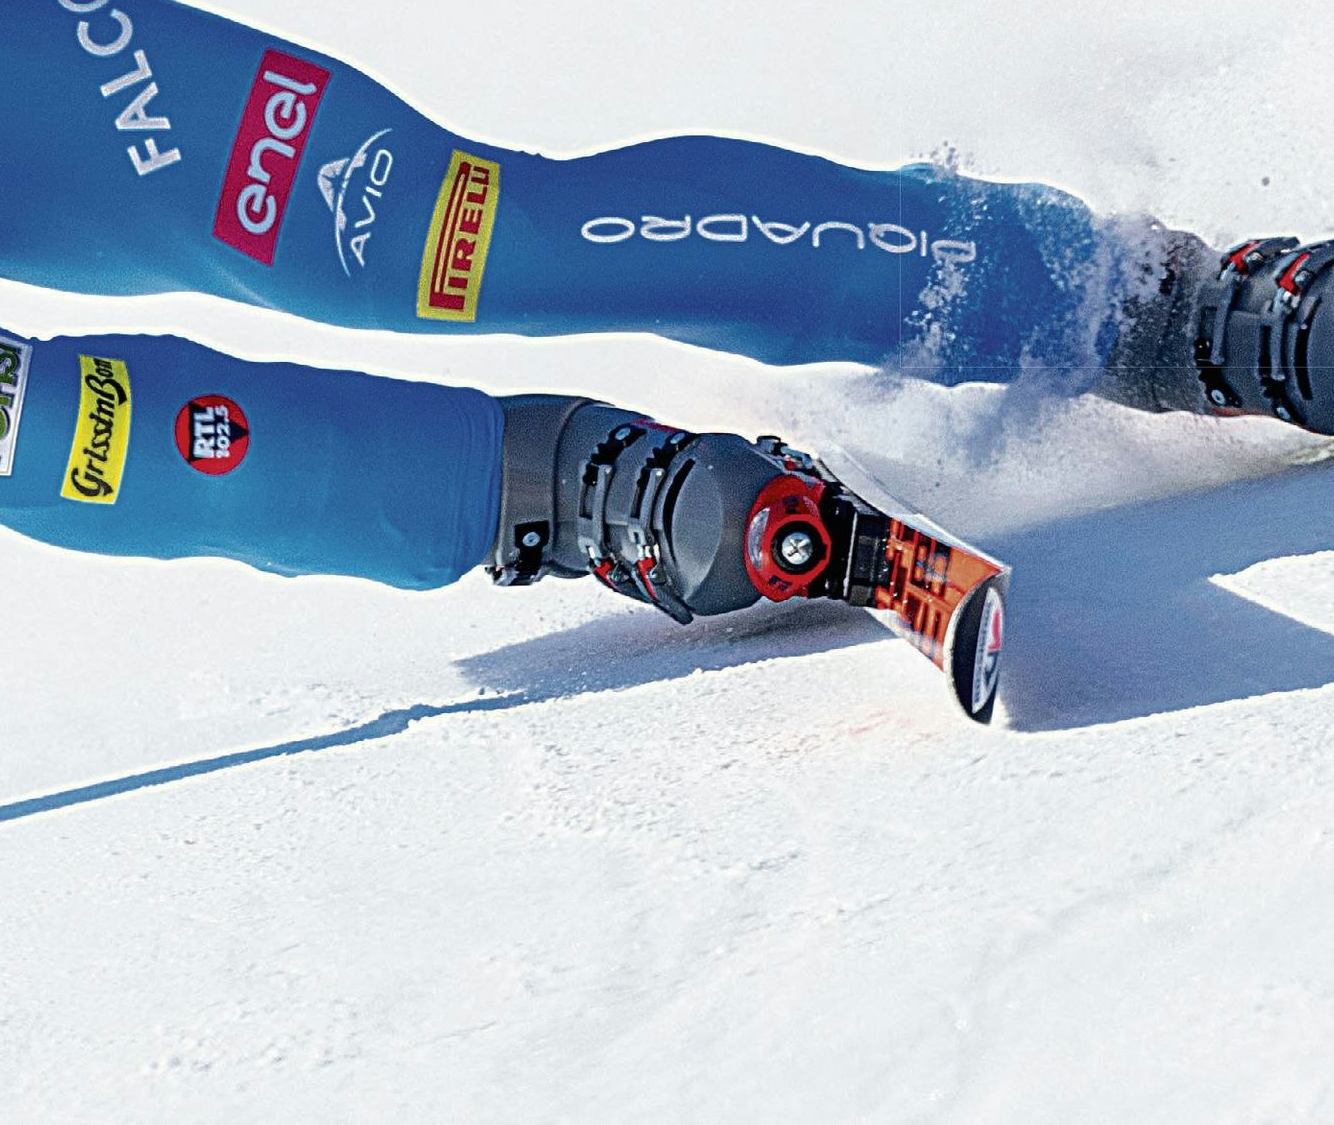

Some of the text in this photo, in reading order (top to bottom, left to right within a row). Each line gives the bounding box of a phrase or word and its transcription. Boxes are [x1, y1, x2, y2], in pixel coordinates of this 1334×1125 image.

[234, 70, 318, 237] enel
[349, 148, 394, 267] AVIO
[428, 161, 490, 312] PIRELLI
[581, 213, 977, 263] PIQUADRO
[193, 406, 215, 458] RTL
[215, 405, 231, 458] 102.5
